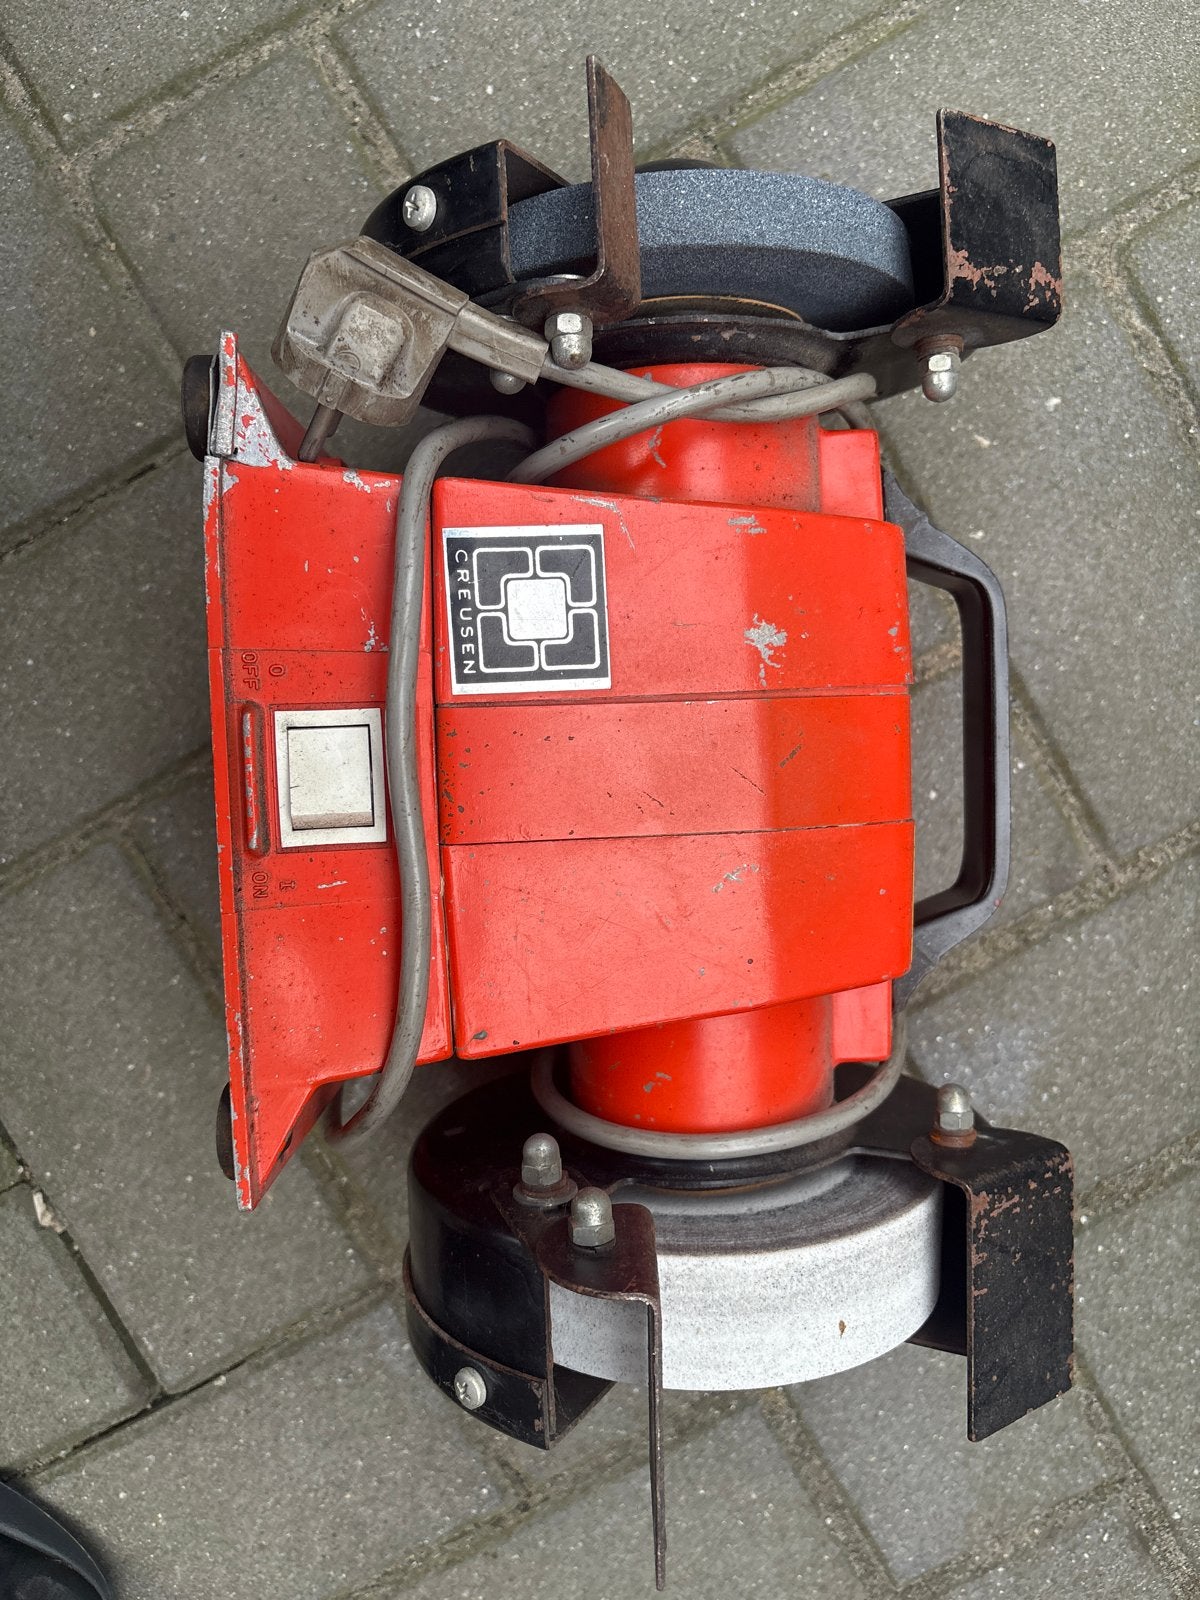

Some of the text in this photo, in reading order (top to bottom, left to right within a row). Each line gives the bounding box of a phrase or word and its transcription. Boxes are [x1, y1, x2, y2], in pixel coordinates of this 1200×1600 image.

[455, 549, 476, 674] CREUSEN
[241, 652, 259, 690] OFF
[252, 871, 268, 898] ON
